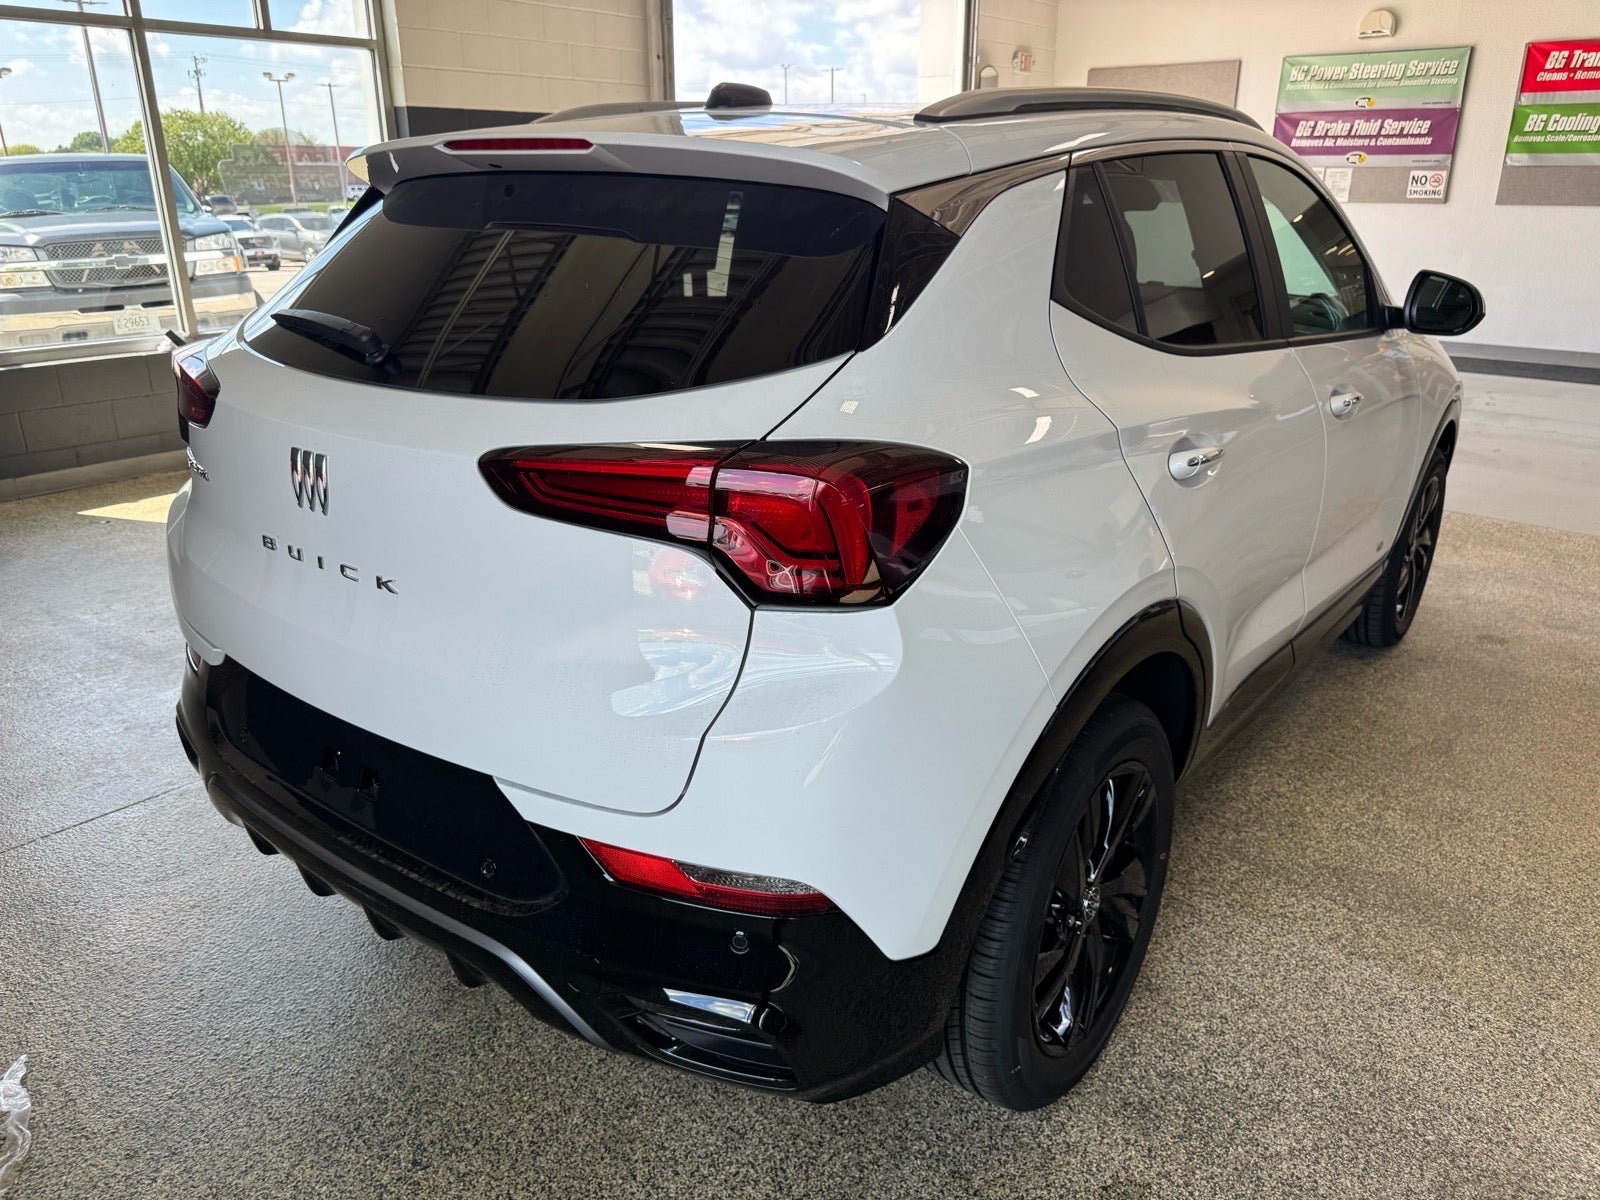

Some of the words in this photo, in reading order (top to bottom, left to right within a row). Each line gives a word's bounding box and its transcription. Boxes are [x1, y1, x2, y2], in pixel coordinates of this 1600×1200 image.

[1544, 50, 1570, 70] BG
[1289, 65, 1308, 82] BG
[1307, 65, 1348, 80] Power
[1348, 61, 1406, 81] Steering
[1406, 58, 1459, 77] Service
[1536, 71, 1568, 82] Cleans
[1430, 77, 1458, 86] Steering
[1295, 120, 1316, 137] BG
[1313, 120, 1351, 137] Brake
[1351, 118, 1382, 136] Fluid
[1381, 118, 1432, 135] Service
[1523, 113, 1548, 132] BG
[1546, 112, 1600, 134] Cooling
[1290, 137, 1324, 148] Removes
[1335, 136, 1370, 147] Moisture
[1369, 137, 1377, 146] &
[1376, 136, 1433, 146] Contaminants
[1513, 134, 1546, 143] Removes
[1410, 174, 1428, 187] NO
[1408, 188, 1442, 197] SMOKING
[261, 534, 399, 595] BUICK
